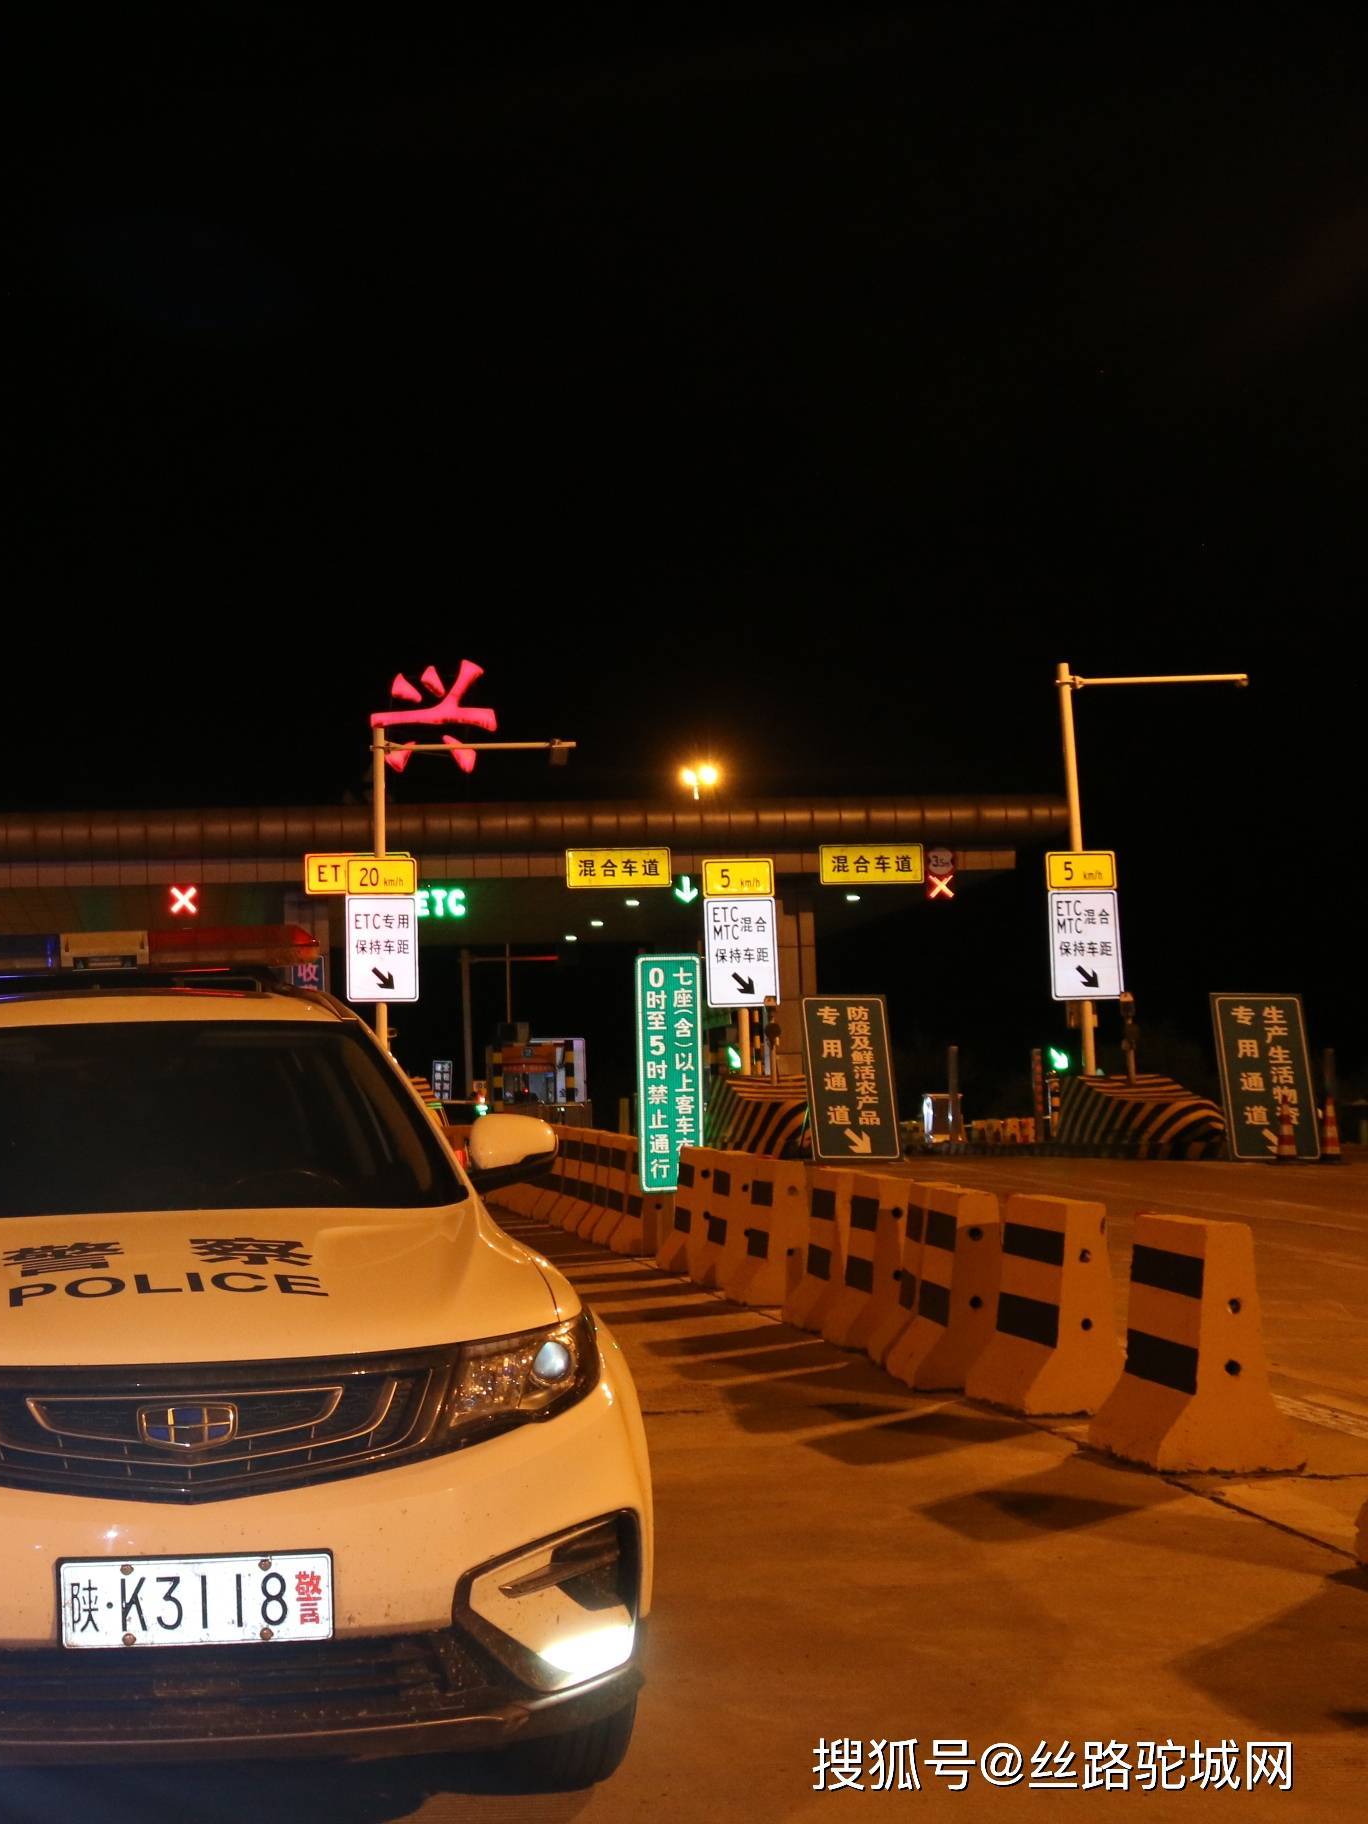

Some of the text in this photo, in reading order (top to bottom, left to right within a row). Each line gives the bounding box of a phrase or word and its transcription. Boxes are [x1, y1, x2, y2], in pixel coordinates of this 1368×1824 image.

[370, 658, 498, 773] 兴
[317, 864, 347, 883] ET
[578, 859, 660, 878] 混合车道
[831, 855, 913, 873] 混合车道
[1063, 861, 1104, 880] 5 km/h
[359, 867, 404, 887] 20 km/h
[720, 868, 761, 888] 5 km/h
[415, 888, 466, 917] ETC
[1056, 900, 1082, 917] ETC
[354, 913, 409, 930] ETC专用
[712, 906, 739, 923] ETC
[1084, 908, 1110, 925] 混合
[713, 924, 740, 941] MTC
[740, 916, 767, 933] 混合
[1057, 917, 1083, 934] MTC
[355, 939, 410, 955] 保持车距
[715, 947, 770, 964] 保持车距
[1059, 941, 1113, 957] 保持车距
[297, 962, 320, 991] 收
[646, 967, 671, 1180] 0时至5时禁止通行
[816, 1006, 852, 1126] 专用通道
[846, 1006, 881, 1126] 防疫及鲜活农产品
[1230, 1005, 1271, 1126] 专用通道
[1, 1237, 313, 1278] 警察
[9, 1271, 329, 1308] POLICE
